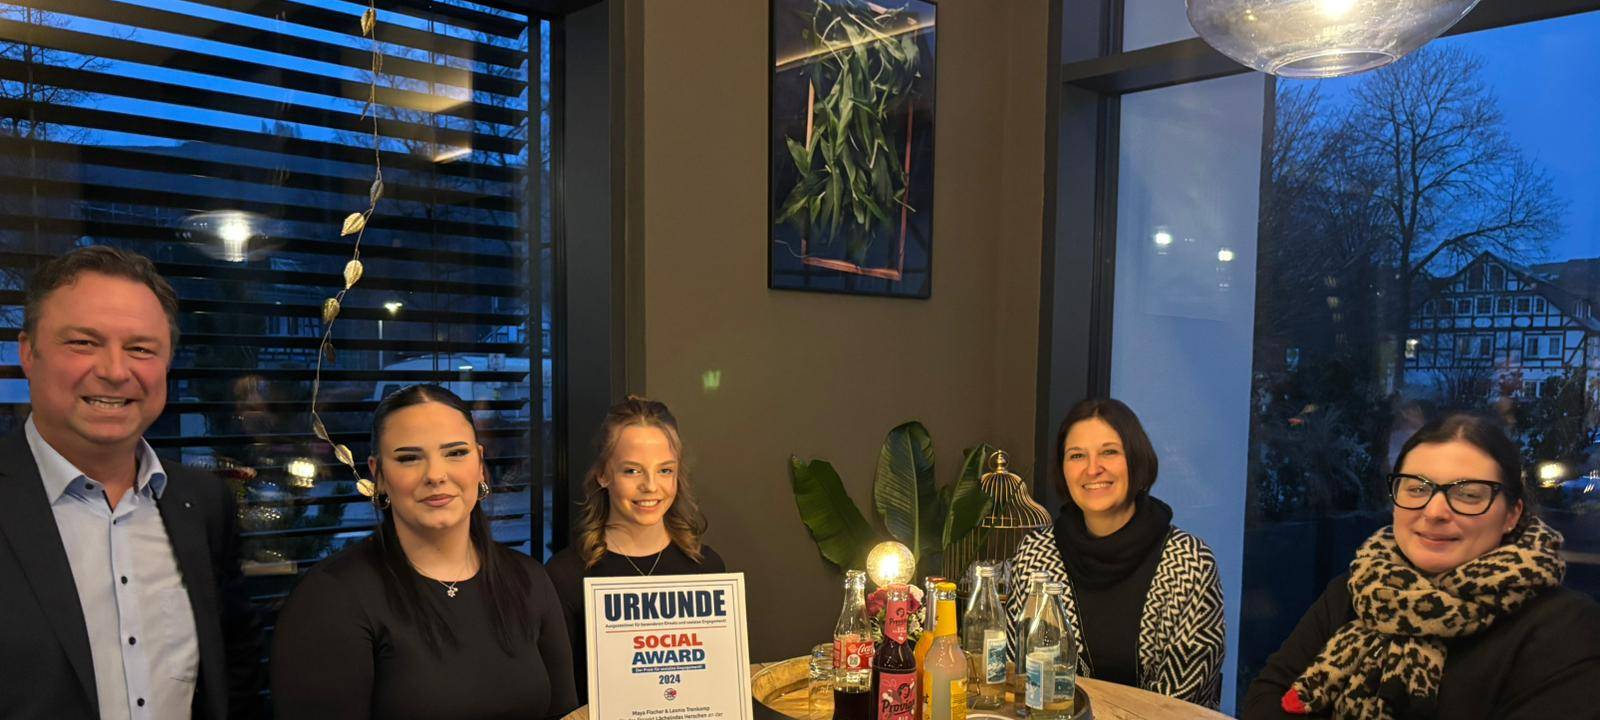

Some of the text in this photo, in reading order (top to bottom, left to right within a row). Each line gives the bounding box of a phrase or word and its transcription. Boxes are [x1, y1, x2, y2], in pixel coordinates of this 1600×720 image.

[604, 590, 726, 621] URKUNDE
[633, 633, 703, 649] SOCIAL
[631, 648, 706, 665] AWARD
[658, 674, 681, 685] 2024
